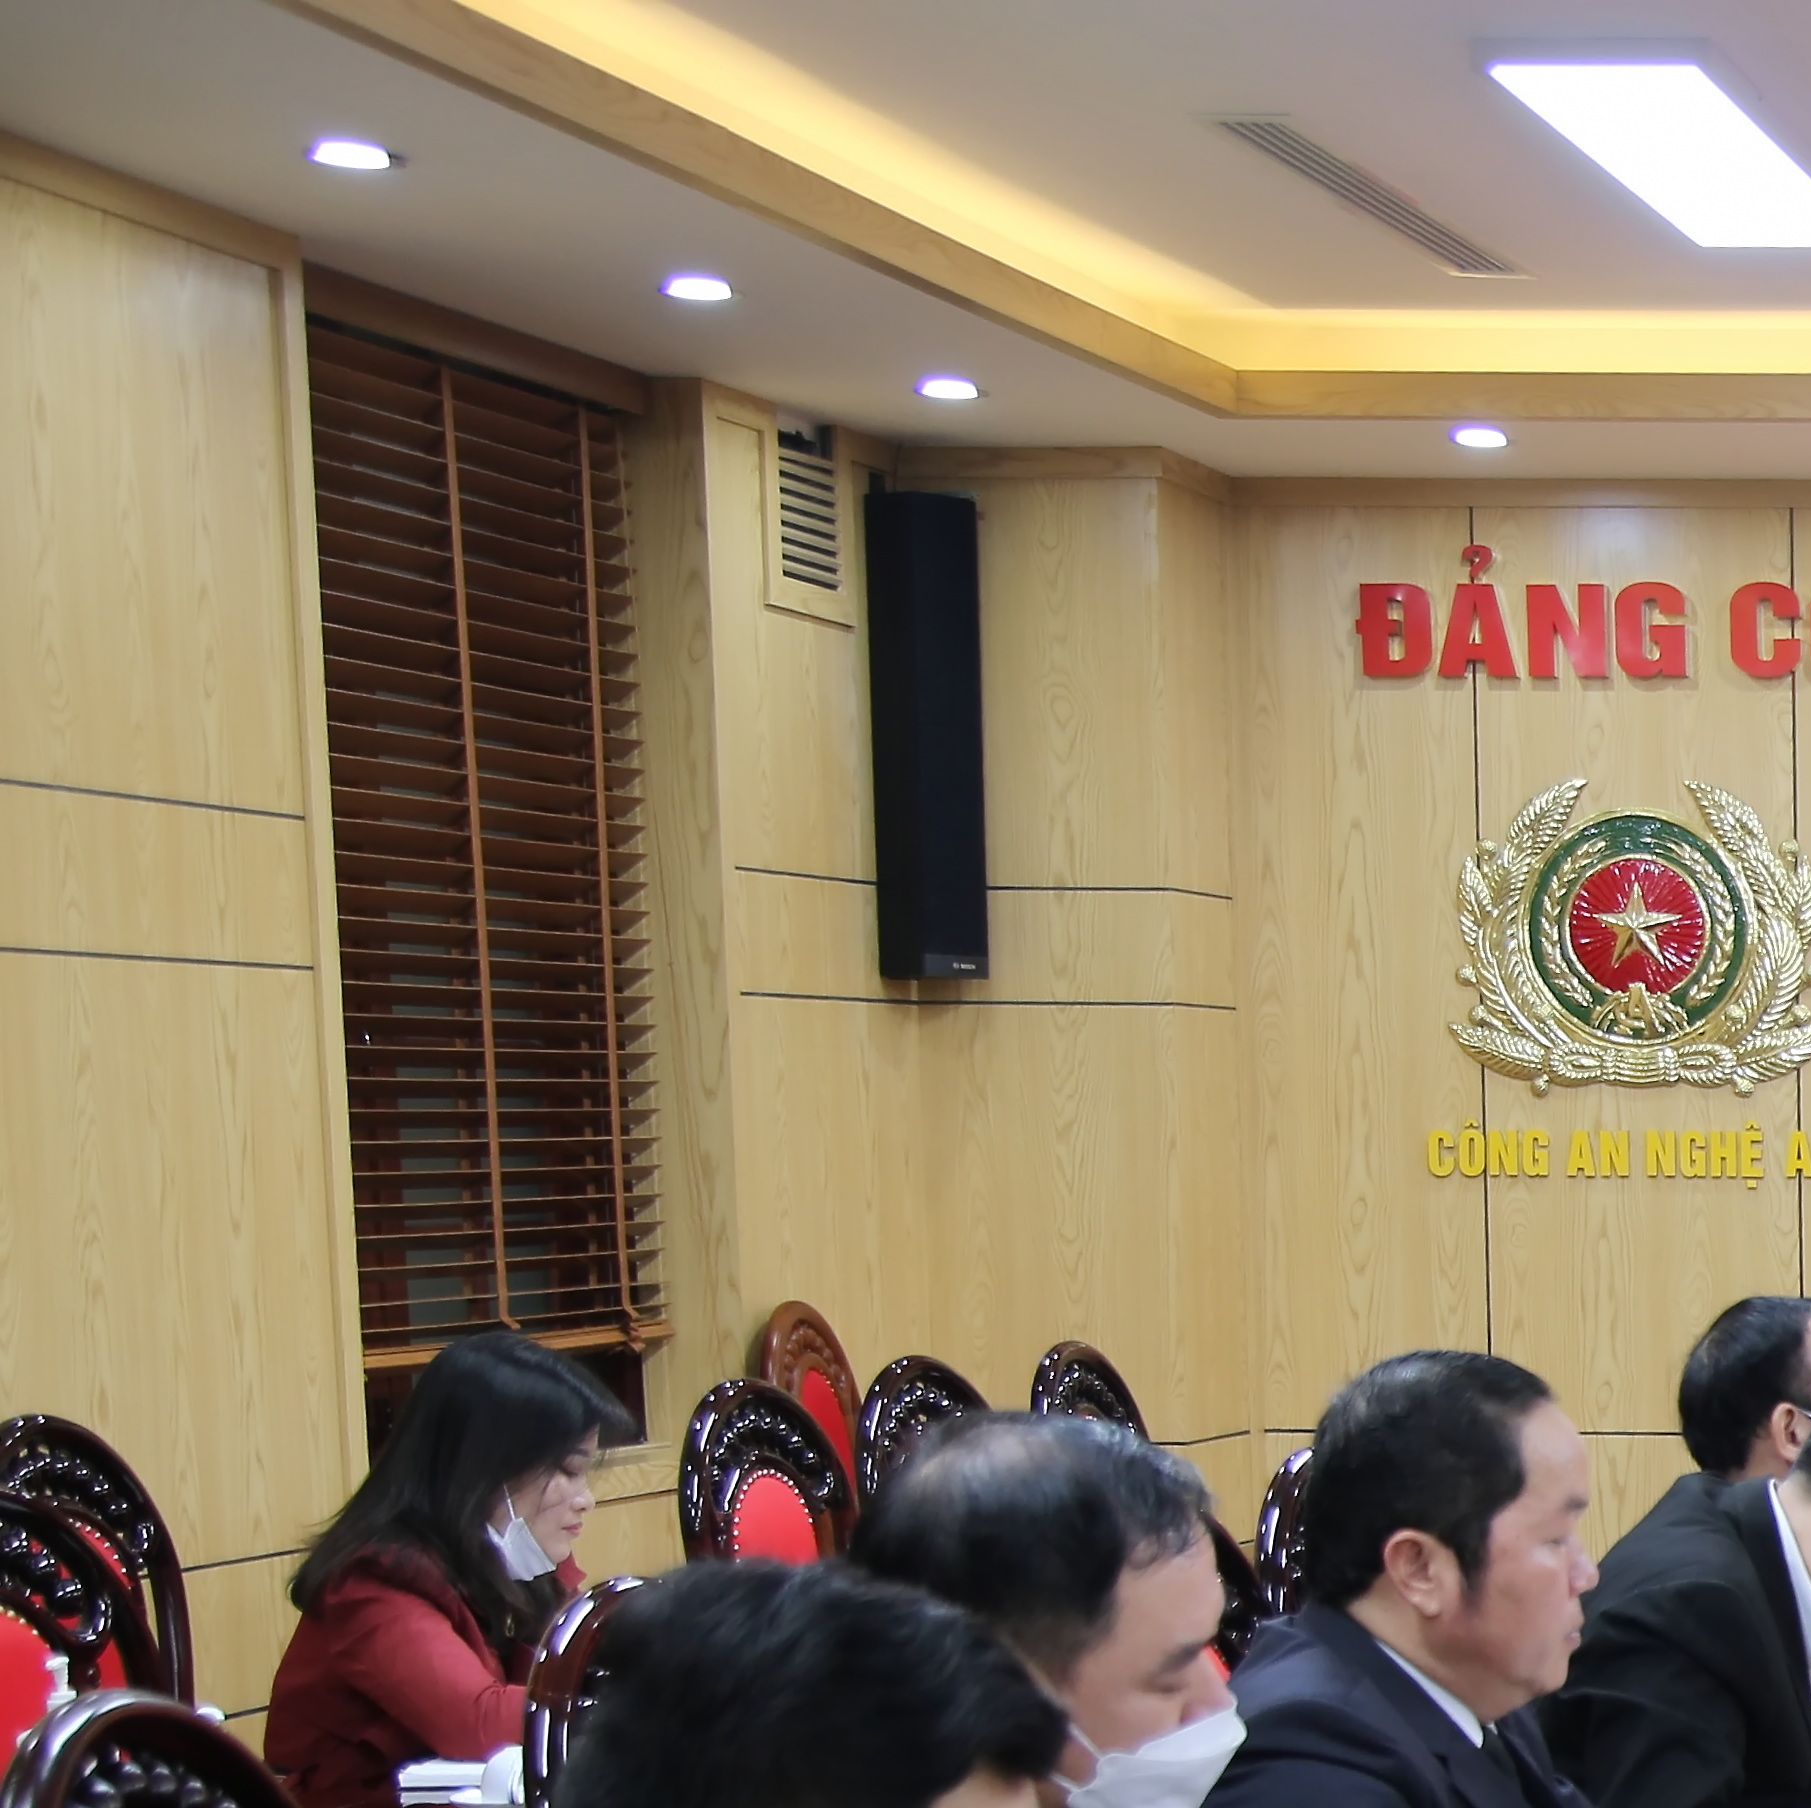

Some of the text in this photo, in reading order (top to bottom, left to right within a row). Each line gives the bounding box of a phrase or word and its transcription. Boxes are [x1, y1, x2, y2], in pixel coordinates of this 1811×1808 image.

[1356, 545, 1687, 682] ĐẢNG
[1426, 1118, 1550, 1179] CÔNG
[1566, 1130, 1630, 1179] AN
[1645, 1121, 1765, 1189] NGHỆ
